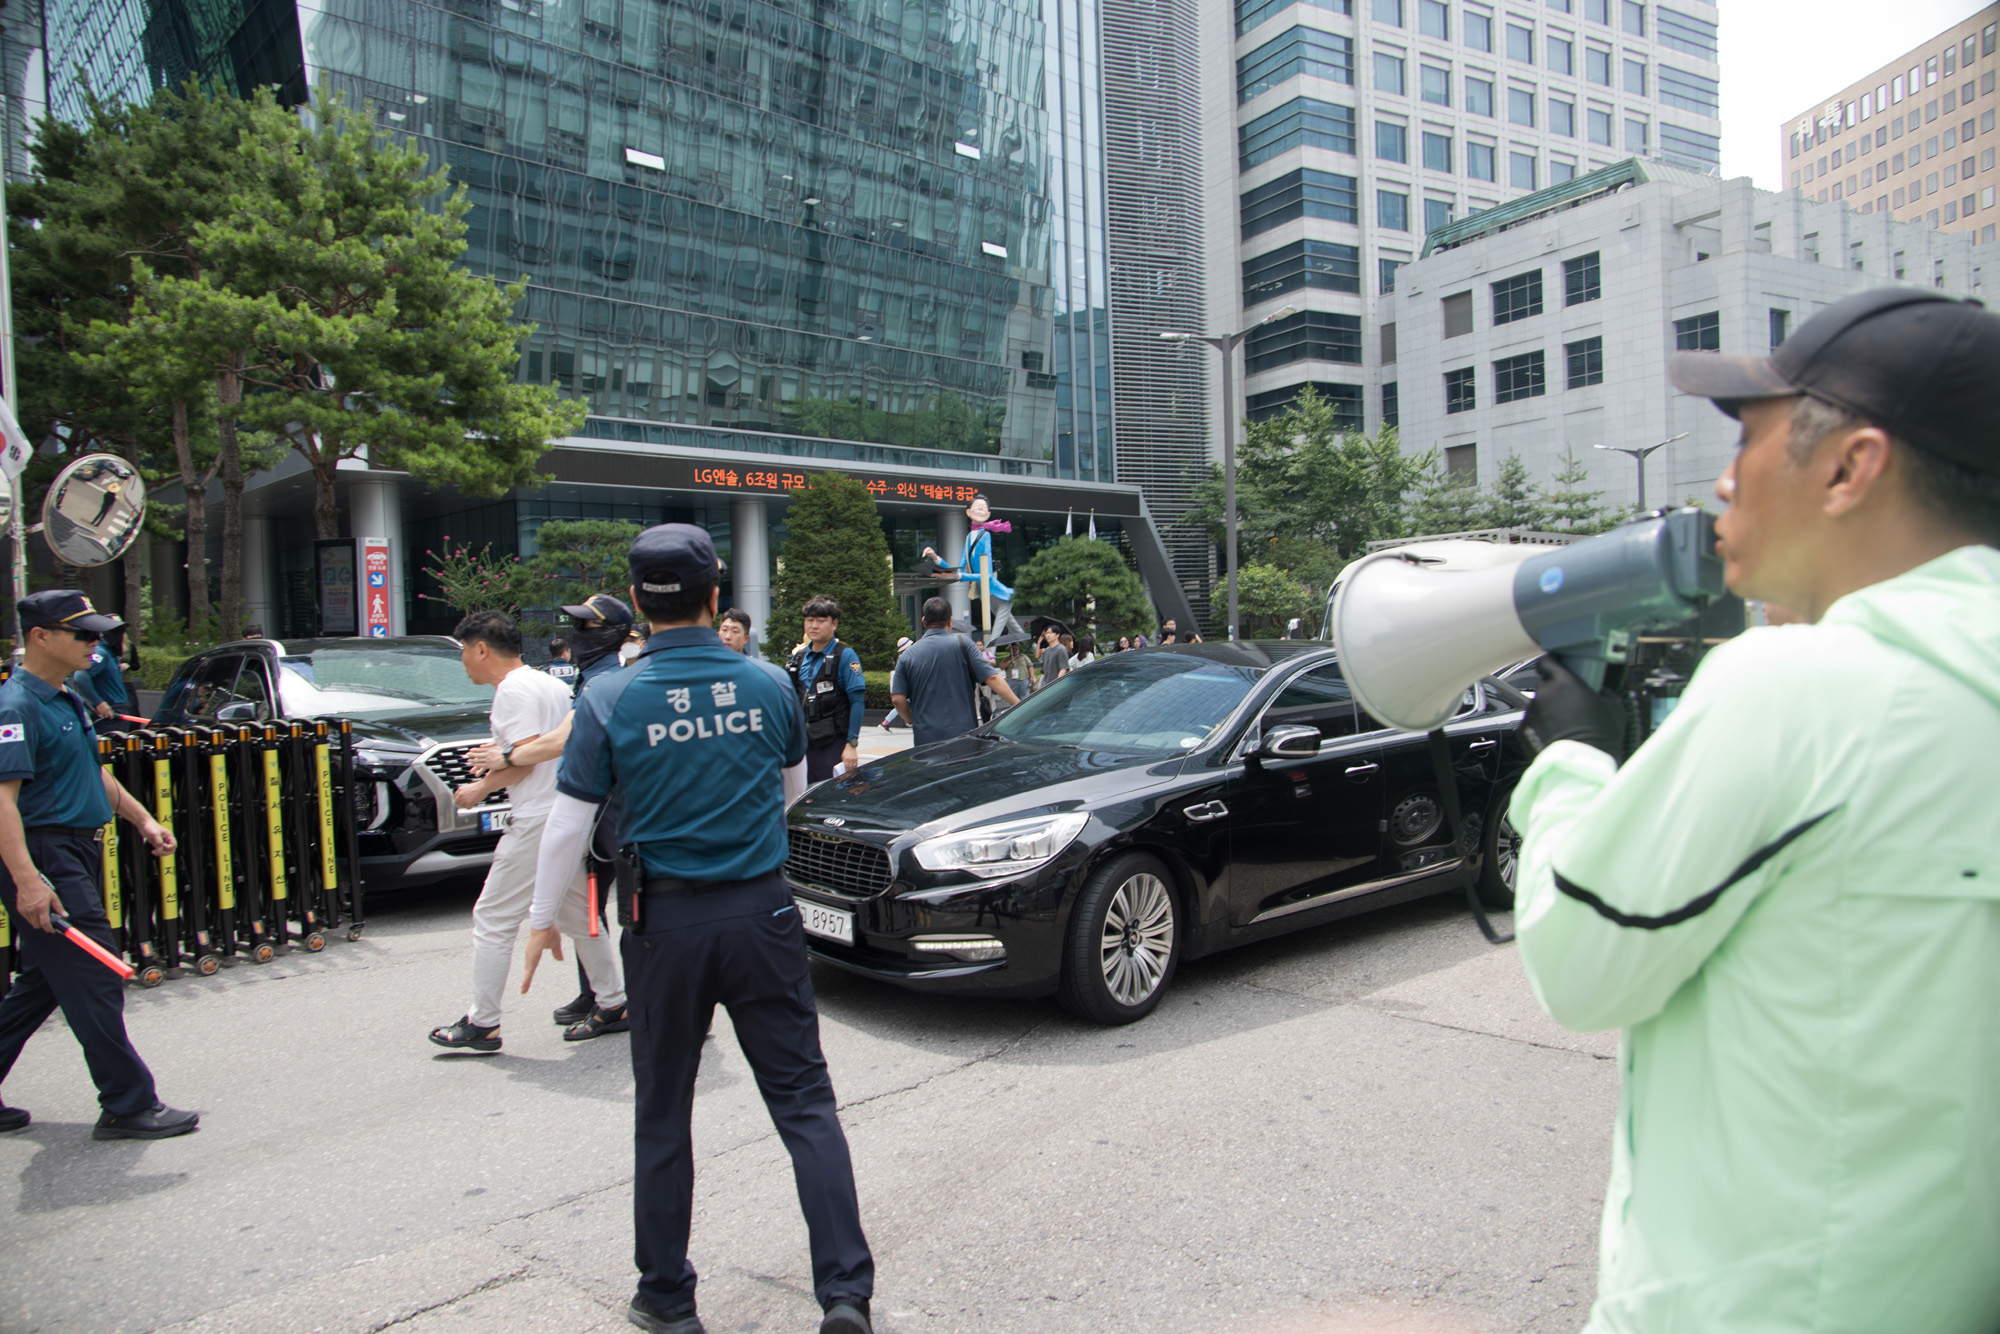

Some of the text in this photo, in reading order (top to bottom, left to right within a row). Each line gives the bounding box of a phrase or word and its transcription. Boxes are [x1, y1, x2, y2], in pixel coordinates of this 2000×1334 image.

[694, 468, 742, 487] LG엔솔,
[745, 471, 778, 489] 6조원
[781, 473, 806, 489] 규모
[647, 708, 763, 747] POLICE
[218, 783, 231, 892] POLICE LINE
[322, 771, 335, 874] POLICE LINE
[110, 870, 119, 910] LINE
[813, 909, 845, 935] 8957
